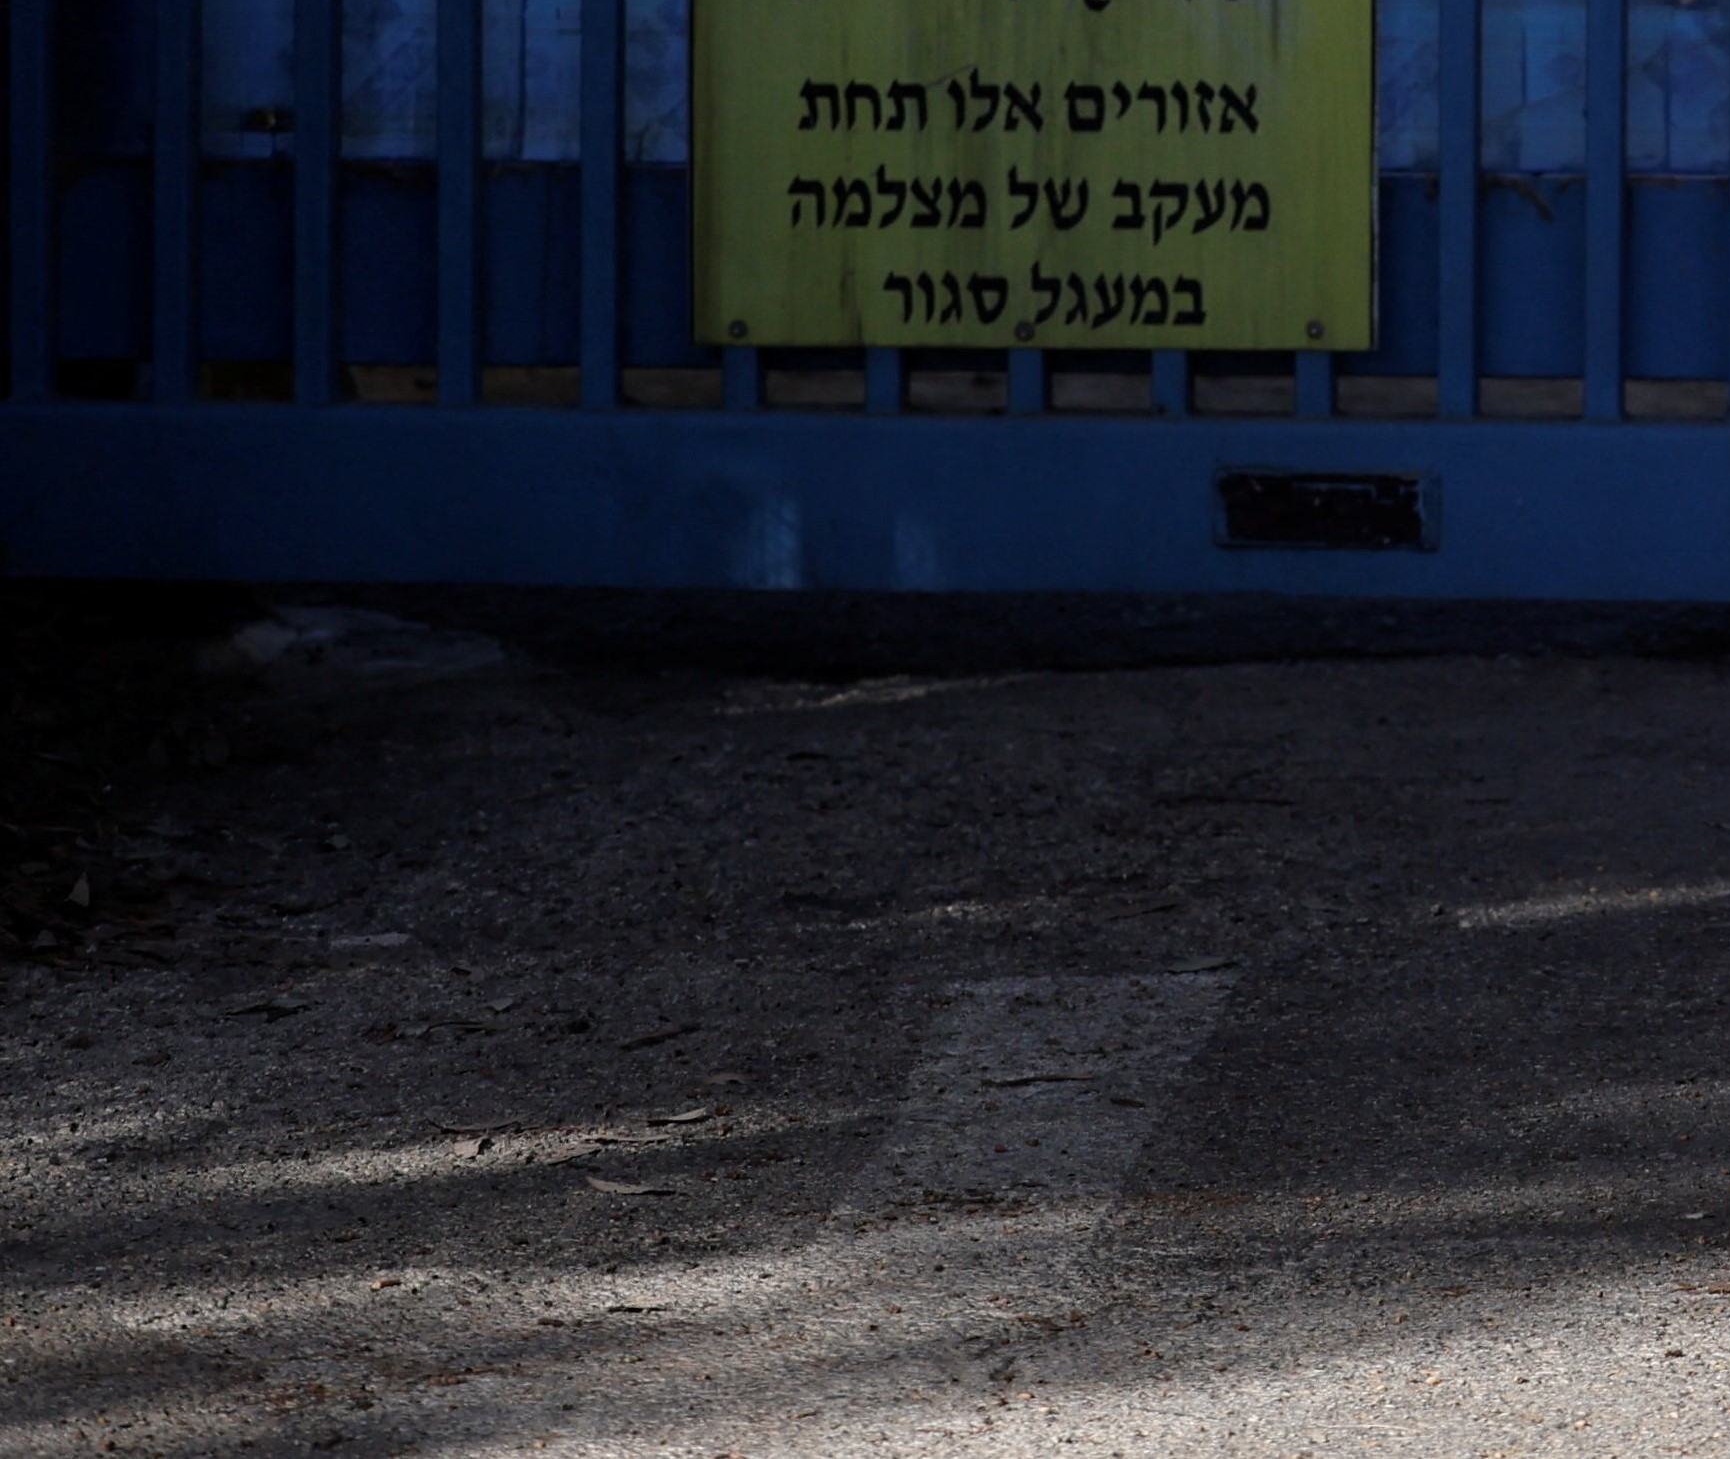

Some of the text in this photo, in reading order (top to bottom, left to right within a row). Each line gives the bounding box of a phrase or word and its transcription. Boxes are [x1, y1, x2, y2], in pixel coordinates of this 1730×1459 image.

[799, 67, 1259, 134] אזורים אלו תחת
[788, 164, 1270, 246] מעקב של מצלמה
[883, 261, 1206, 330] במעגל סגור
